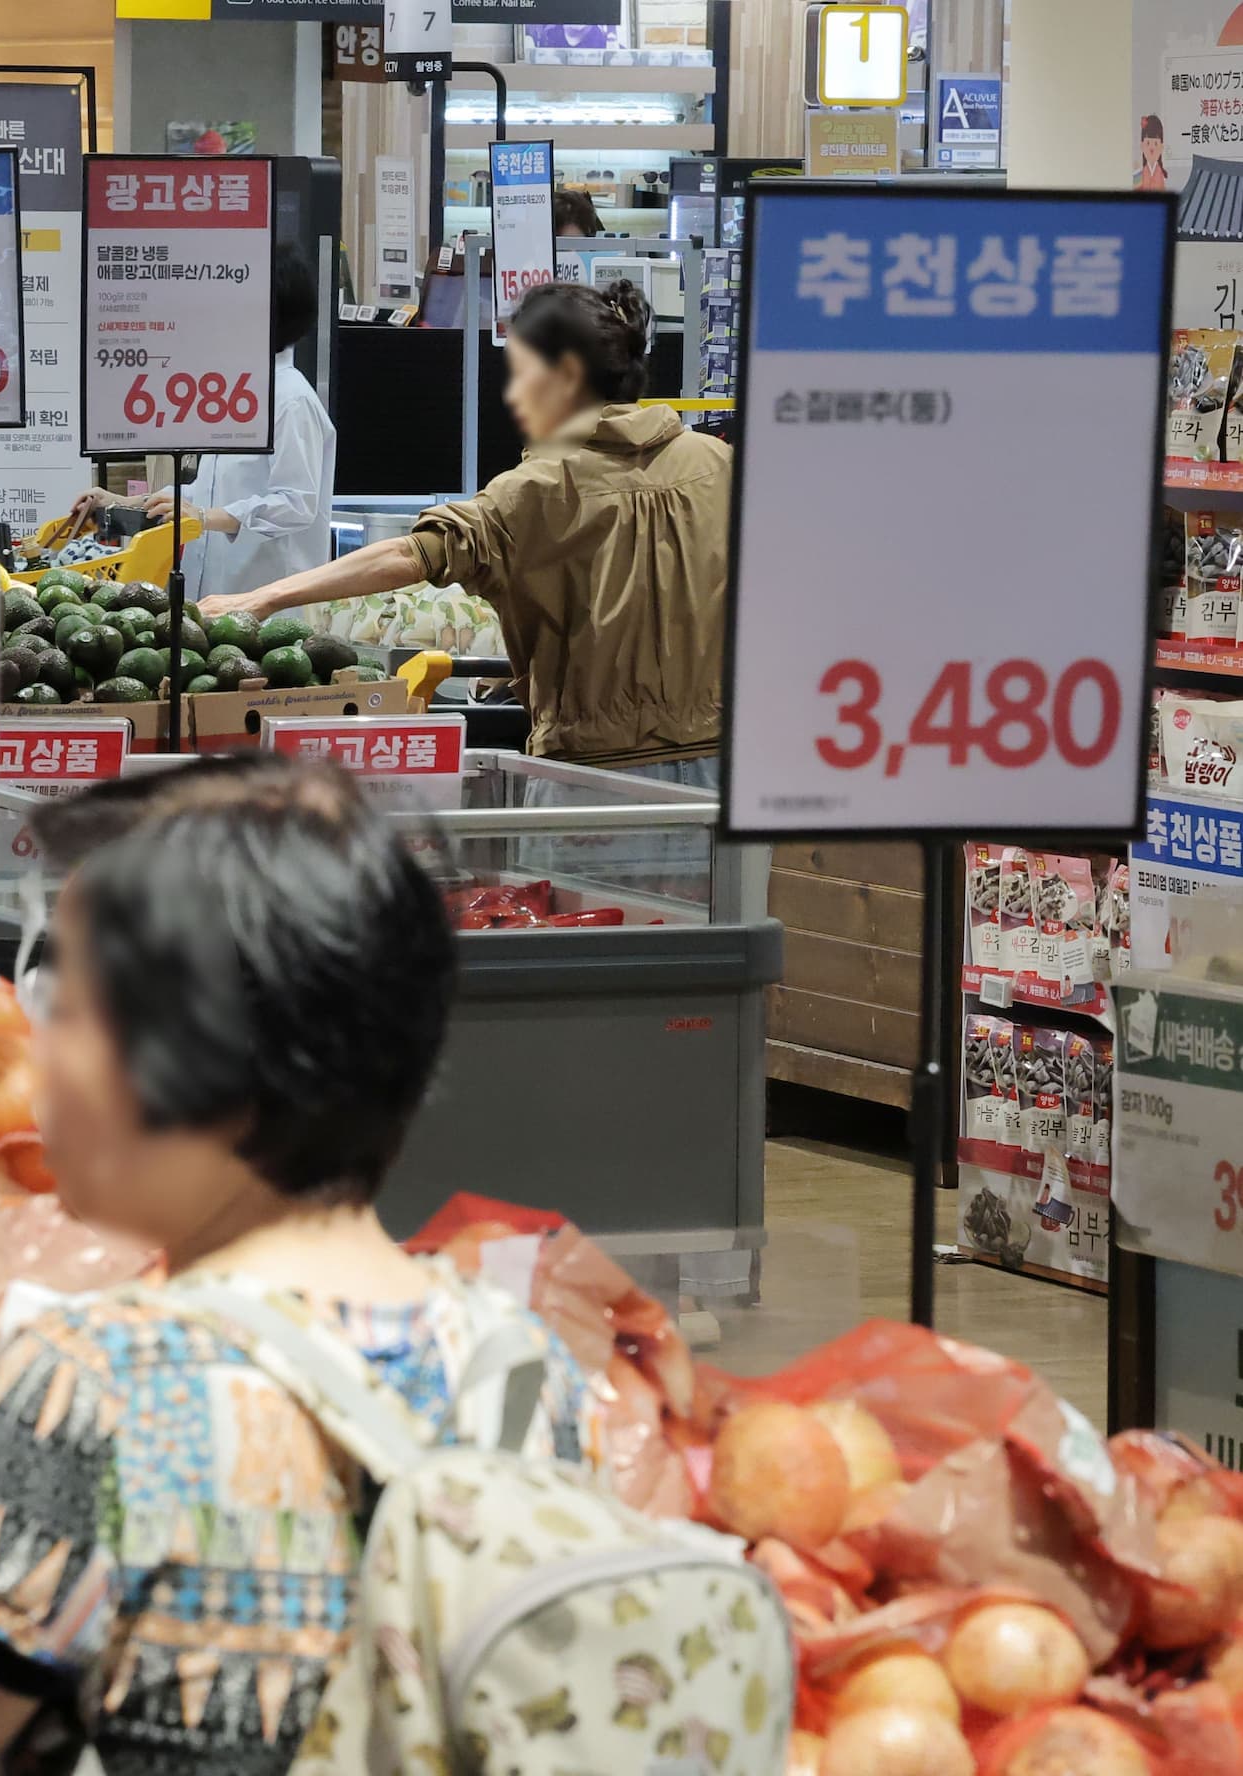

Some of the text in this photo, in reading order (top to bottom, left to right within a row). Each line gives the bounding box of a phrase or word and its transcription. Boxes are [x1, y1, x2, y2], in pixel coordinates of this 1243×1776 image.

[422, 11, 436, 32] 7
[336, 25, 381, 66] 안경
[849, 12, 870, 63] 1
[415, 60, 443, 73] 촬영중
[963, 93, 997, 102] ACUVUE
[18, 147, 66, 176] 산대
[497, 151, 546, 177] 추천상품
[106, 174, 250, 212] 광고상품
[97, 246, 169, 262] 달콤한 냉동
[97, 263, 250, 284] 애플망고(페루산/1.2kg)
[796, 231, 1125, 319] 추천상품
[29, 349, 58, 366] 적립
[97, 348, 148, 369] 9,980
[123, 371, 259, 428] 6,986
[39, 410, 68, 427] 확인
[9, 488, 46, 504] 구매는
[1201, 601, 1237, 623] 김부
[814, 656, 1123, 779] 3,480
[1146, 808, 1243, 869] 추천상품
[1138, 871, 1191, 896] 프리미엄 데일리
[1156, 1020, 1235, 1072] 새벽배송
[1040, 1095, 1055, 1107] 양반
[1144, 1092, 1174, 1125] 100g
